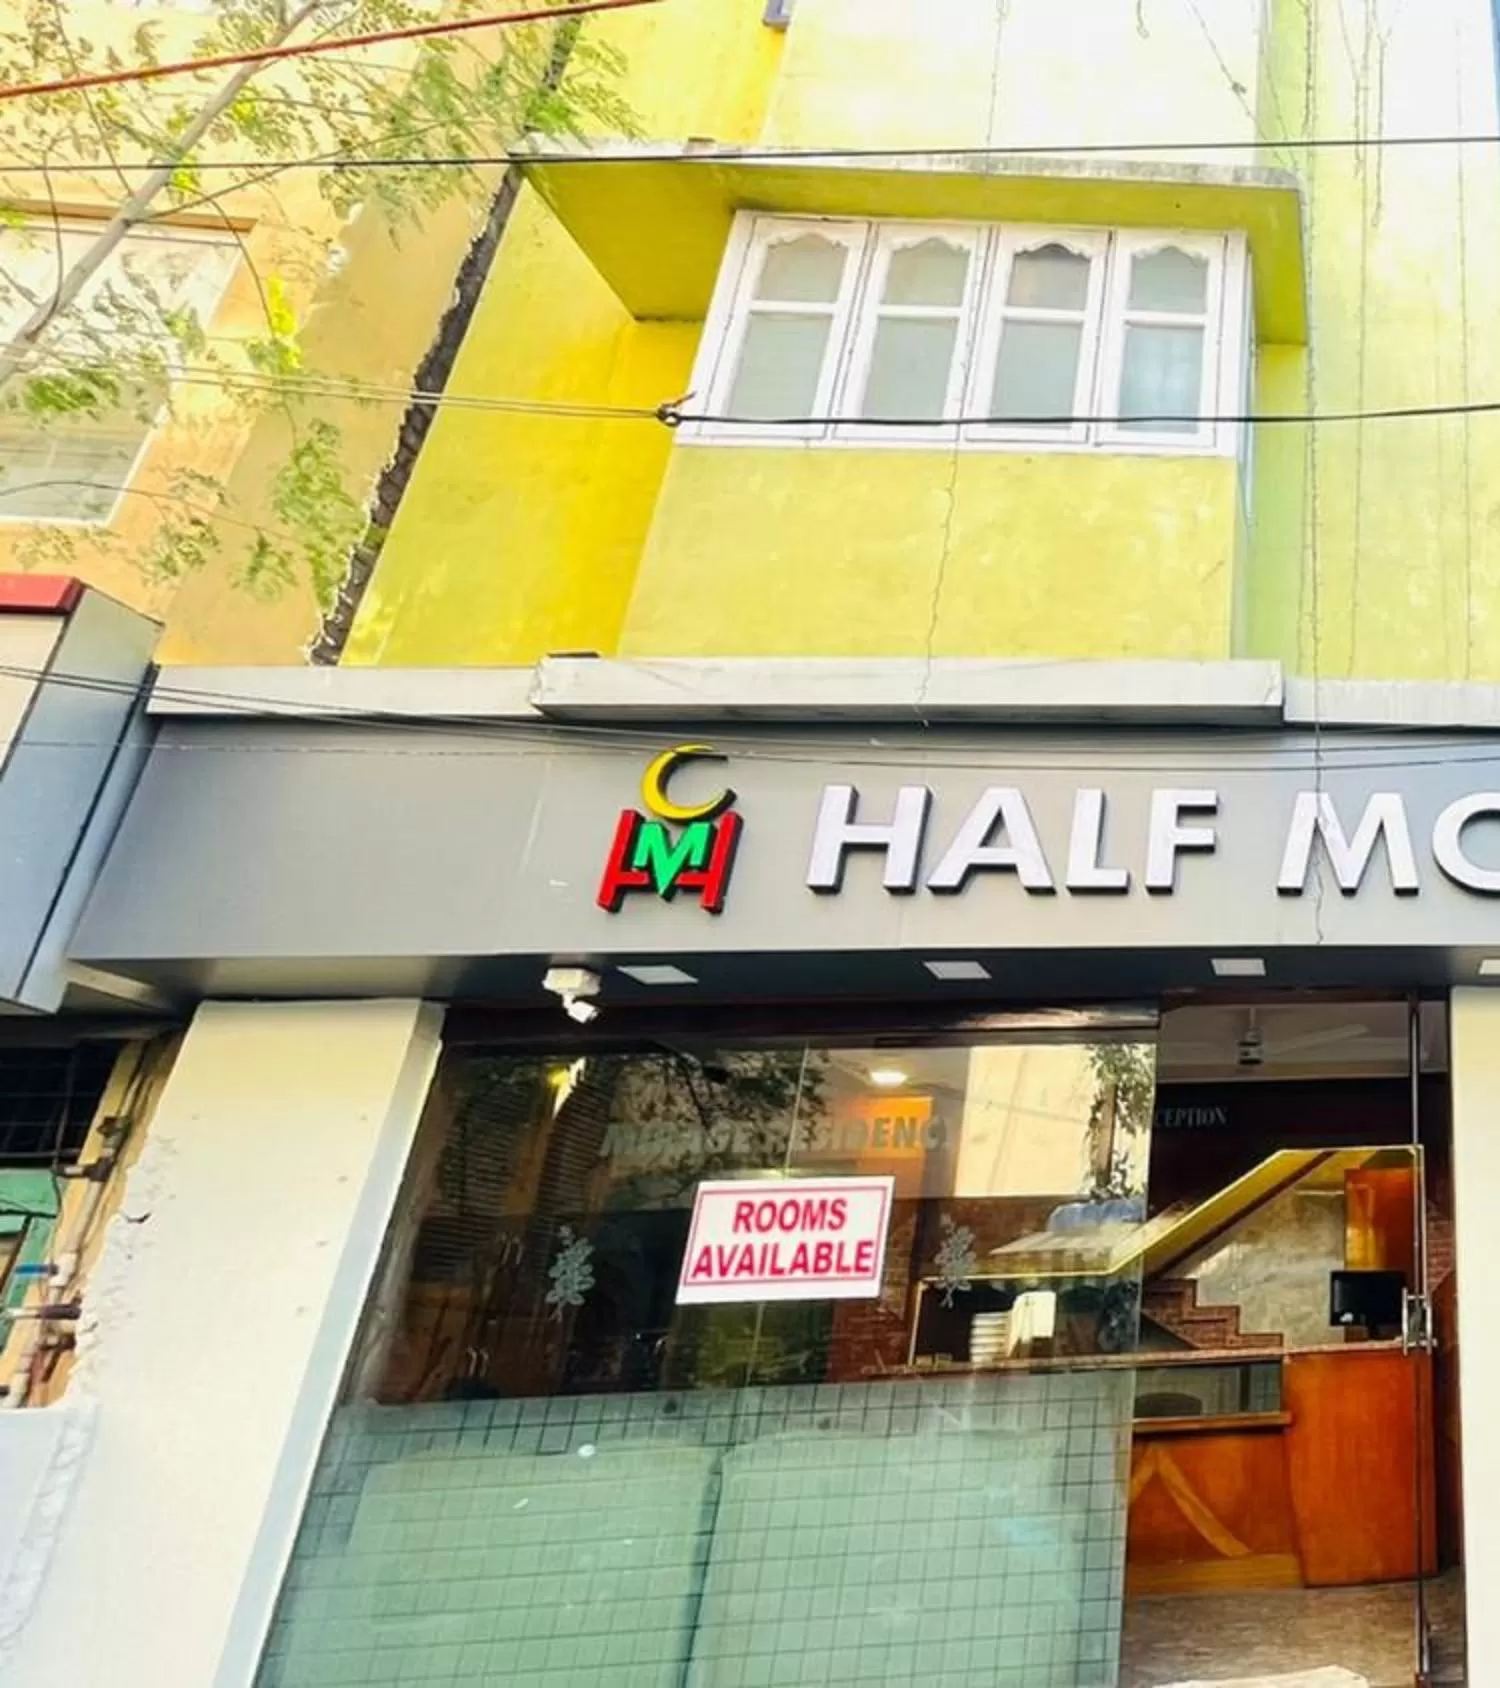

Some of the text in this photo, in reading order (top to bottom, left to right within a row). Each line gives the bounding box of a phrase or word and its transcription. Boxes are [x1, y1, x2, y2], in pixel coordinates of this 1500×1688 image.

[806, 784, 1218, 896] HALF
[732, 1198, 848, 1234] ROOMS
[691, 1241, 874, 1279] AVAILABLE
